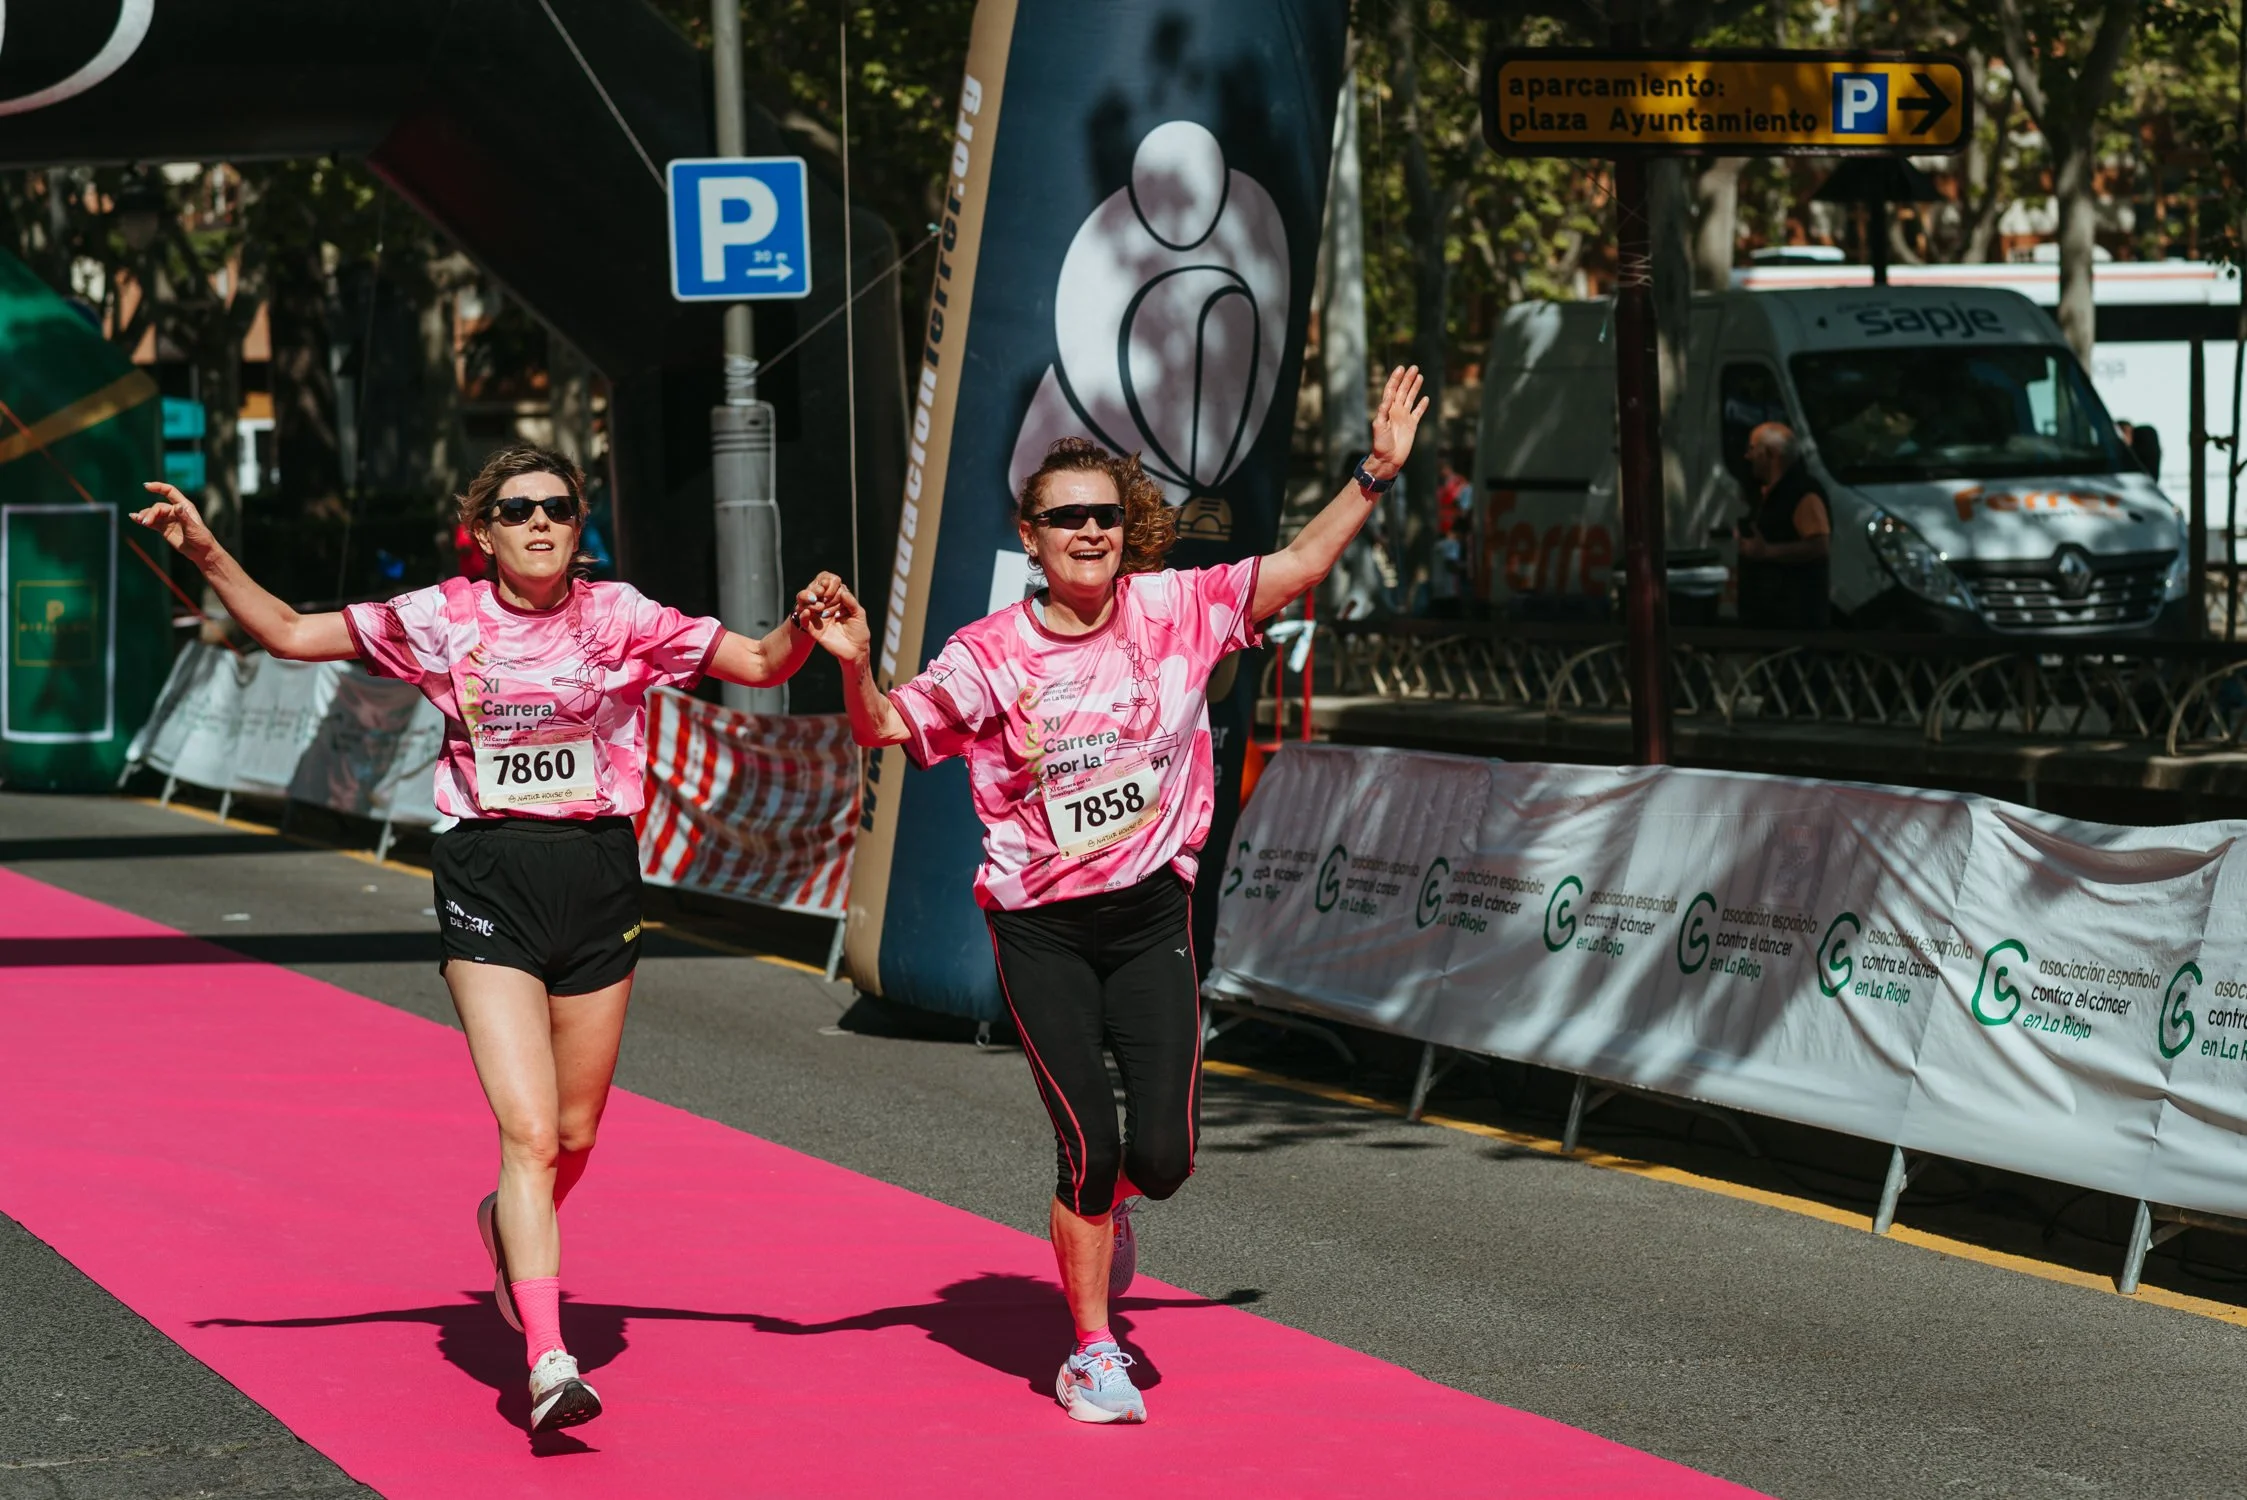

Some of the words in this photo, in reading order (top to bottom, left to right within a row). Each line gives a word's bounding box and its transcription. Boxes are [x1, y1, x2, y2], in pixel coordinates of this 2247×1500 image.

[1508, 73, 1726, 101] aparcamiento:
[1842, 78, 1879, 129] P
[1508, 107, 1589, 136] plaza
[1609, 107, 1819, 136] Ayuntamiento
[698, 175, 779, 283] P
[1480, 489, 1614, 597] Ferre
[482, 678, 499, 694] XI
[481, 699, 553, 717] Carrera
[1043, 716, 1061, 734] XI
[1043, 731, 1118, 755] Carrera
[493, 749, 576, 785] 7860
[1046, 758, 1080, 779] por
[1084, 754, 1103, 769] la
[1065, 781, 1145, 833] 7858
[1620, 914, 1656, 936] cáncer
[1771, 912, 1818, 935] española
[1716, 931, 1748, 949] contra
[1749, 932, 1760, 952] el
[1759, 934, 1794, 956] cáncer
[1710, 956, 1723, 971] en
[1724, 955, 1737, 974] La
[1737, 956, 1762, 981] Rioja
[1862, 953, 1896, 974] contra
[1897, 955, 1910, 977] el
[1909, 958, 1939, 980] cáncer
[2039, 957, 2106, 984] asociación
[2106, 967, 2161, 991] española
[1855, 981, 1869, 997] en
[1870, 979, 1884, 999] La
[1884, 980, 1912, 1008] Rioja
[2031, 984, 2074, 1007] contra
[2074, 988, 2090, 1010] el
[2089, 990, 2132, 1016] cáncer
[2214, 979, 2247, 1000] asoc
[2022, 1012, 2042, 1030] en
[2042, 1011, 2060, 1034] La
[2060, 1014, 2093, 1042] Rioja
[2200, 1039, 2218, 1057] en
[2219, 1036, 2239, 1060] La
